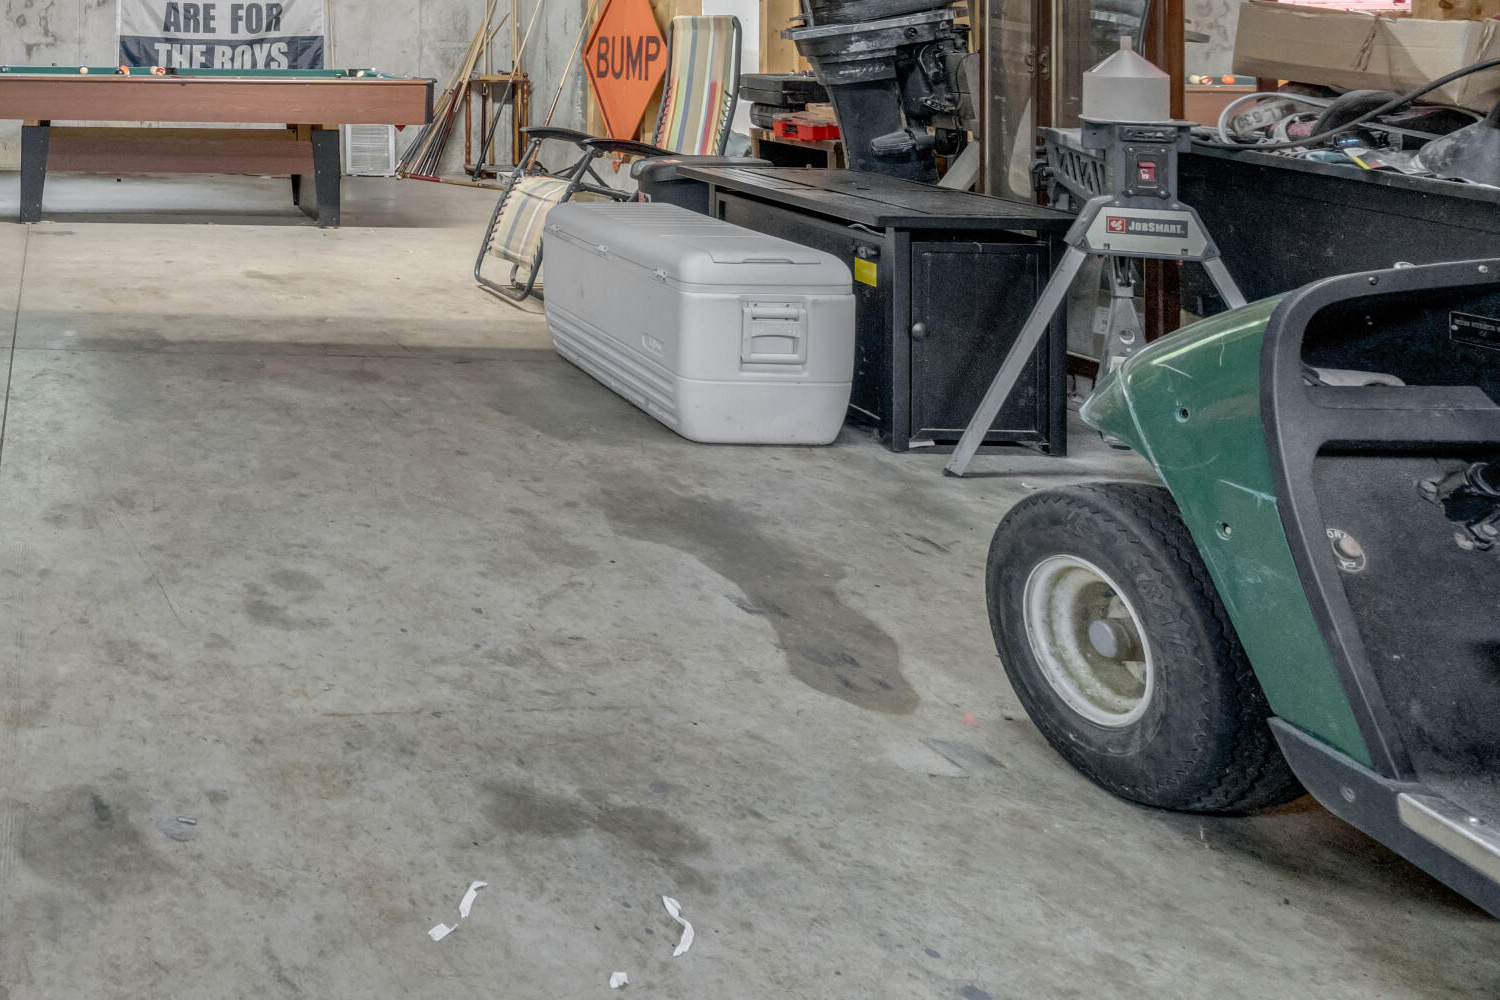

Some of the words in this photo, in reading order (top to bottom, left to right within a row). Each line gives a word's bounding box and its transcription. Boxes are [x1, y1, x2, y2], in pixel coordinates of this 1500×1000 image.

[162, 1, 217, 34] ARE
[230, 2, 284, 34] FOR
[154, 42, 207, 69] THE
[213, 41, 290, 70] BOYS
[596, 35, 661, 82] BUMP
